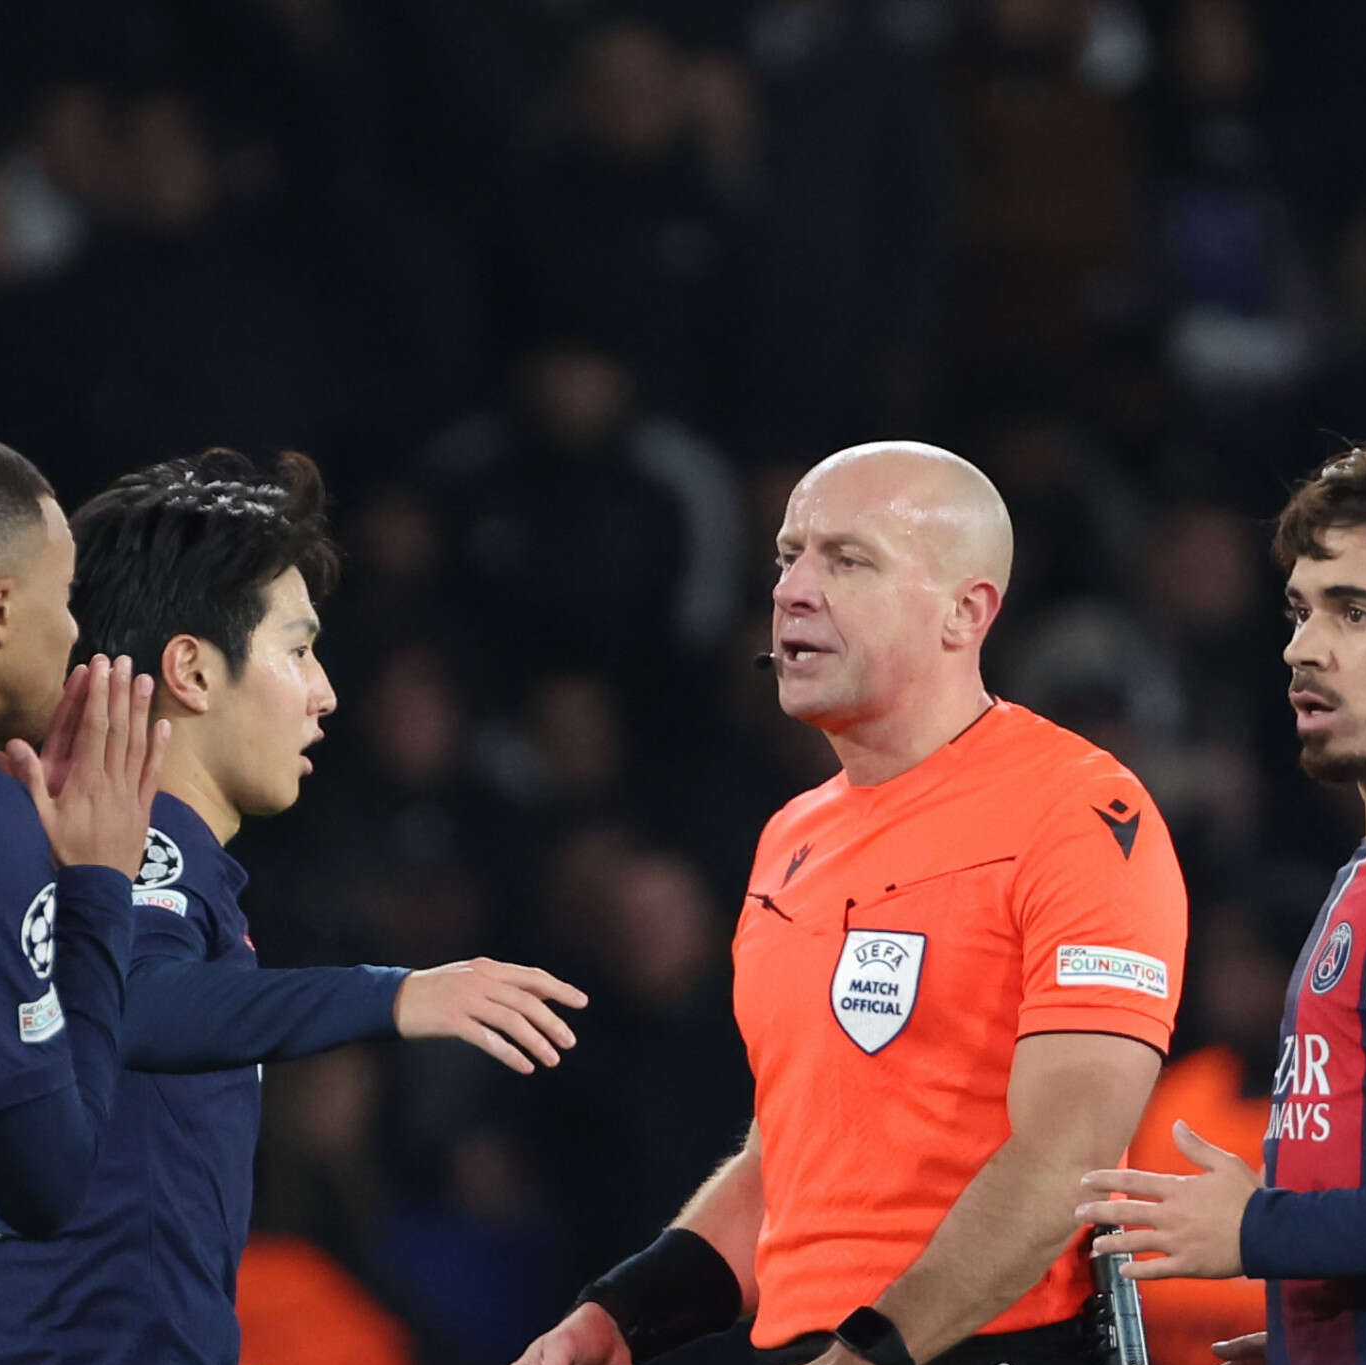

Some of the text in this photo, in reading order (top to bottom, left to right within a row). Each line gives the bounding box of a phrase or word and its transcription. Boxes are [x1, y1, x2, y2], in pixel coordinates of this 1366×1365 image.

[855, 943, 904, 969] UEFA
[1059, 958, 1165, 985] FOUNDATION
[849, 979, 899, 997] MATCH
[841, 997, 903, 1016] OFFICIAL
[1272, 1034, 1331, 1096] TAR
[1262, 1102, 1331, 1142] WAYS
